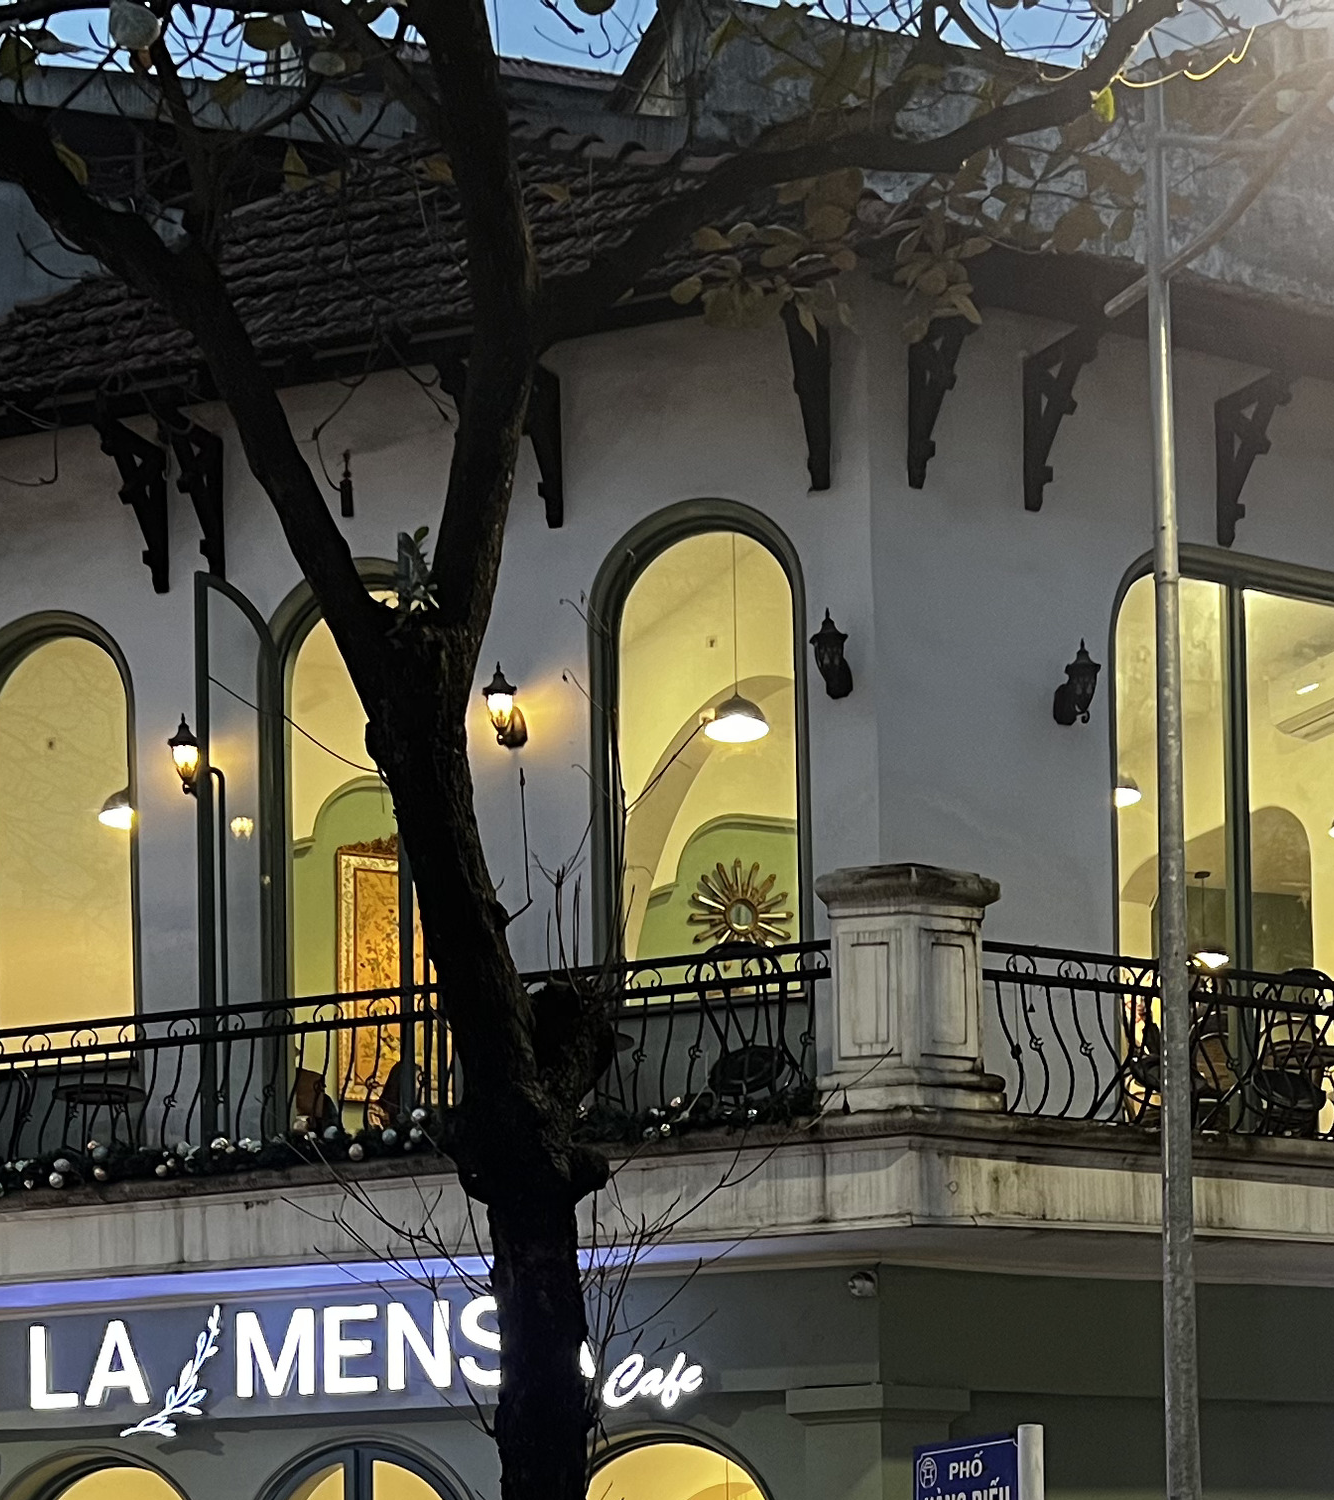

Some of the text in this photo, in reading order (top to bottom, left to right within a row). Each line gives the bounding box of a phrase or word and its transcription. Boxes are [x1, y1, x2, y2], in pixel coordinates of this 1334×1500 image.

[29, 1296, 703, 1410] LA MENS Cafe
[949, 1450, 983, 1480] PHỐ
